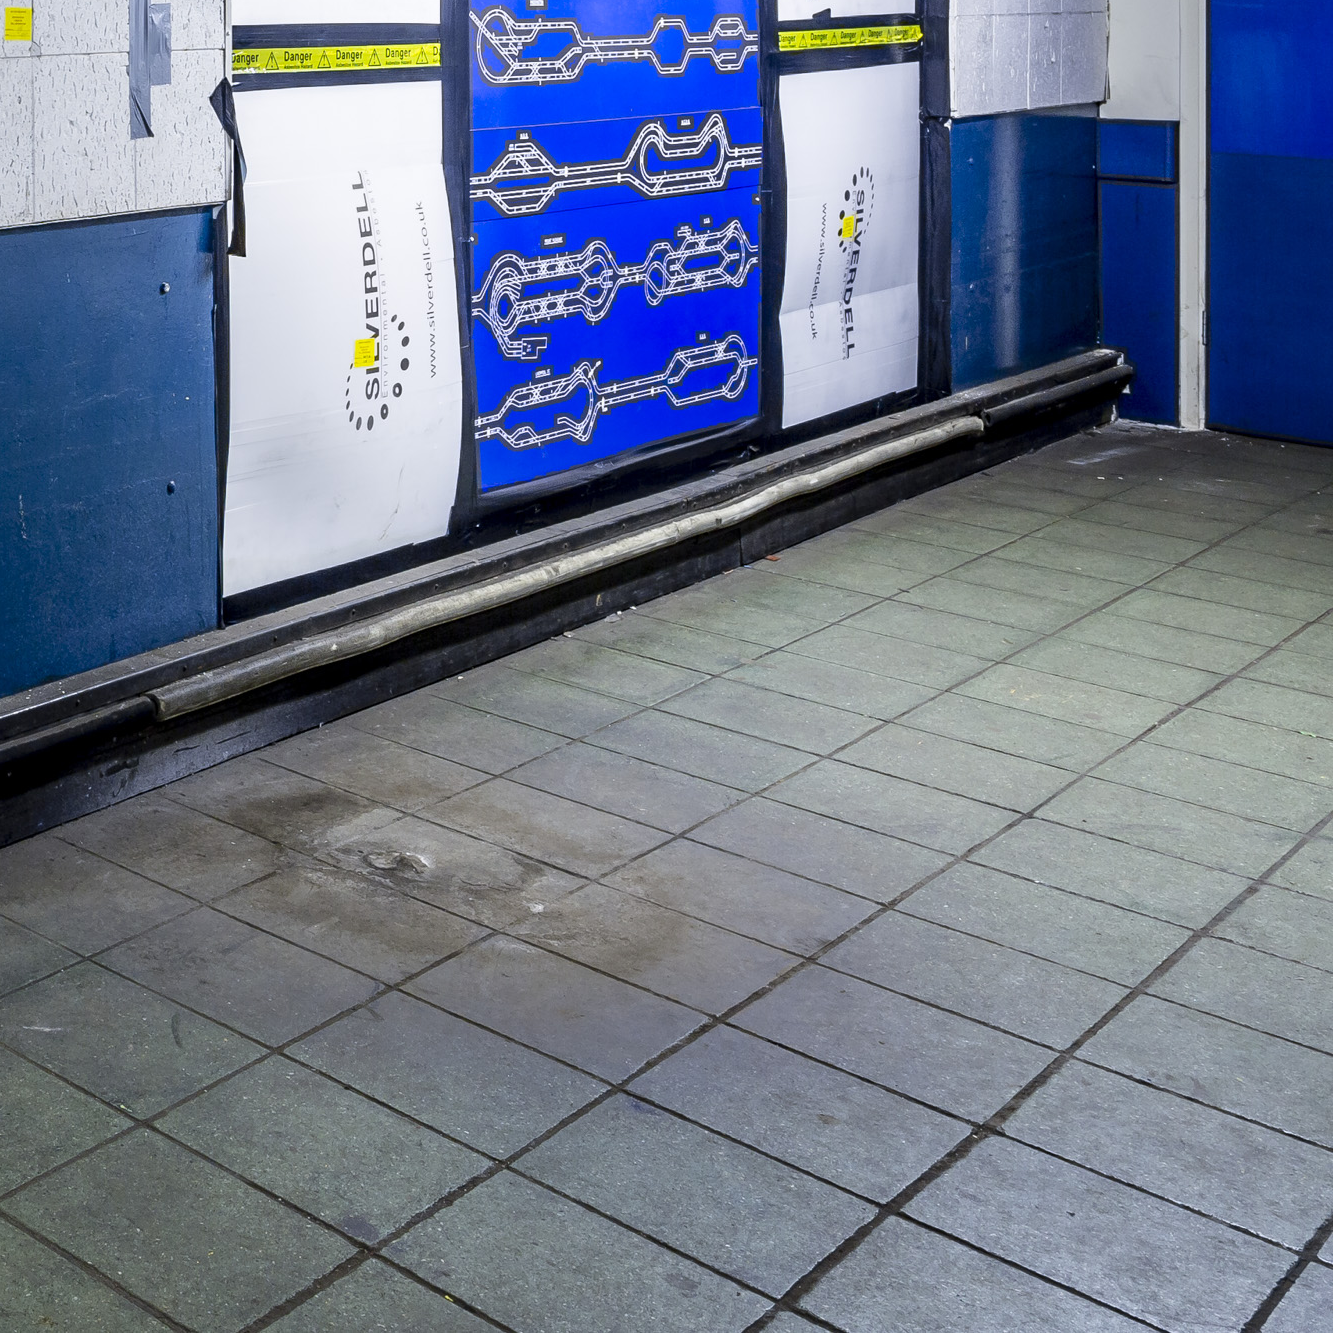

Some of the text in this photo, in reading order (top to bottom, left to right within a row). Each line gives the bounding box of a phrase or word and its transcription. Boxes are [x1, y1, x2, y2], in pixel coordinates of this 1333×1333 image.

[232, 52, 260, 65] Danger
[284, 51, 313, 64] Danger
[336, 49, 363, 62] Danger
[385, 47, 412, 60] Danger
[810, 32, 828, 42] Danger
[840, 31, 857, 41] Danger
[415, 201, 437, 379] www.silverdell.co.uk
[808, 202, 828, 340] www.silverdell.co.uk
[842, 189, 865, 359] SILVERDELL
